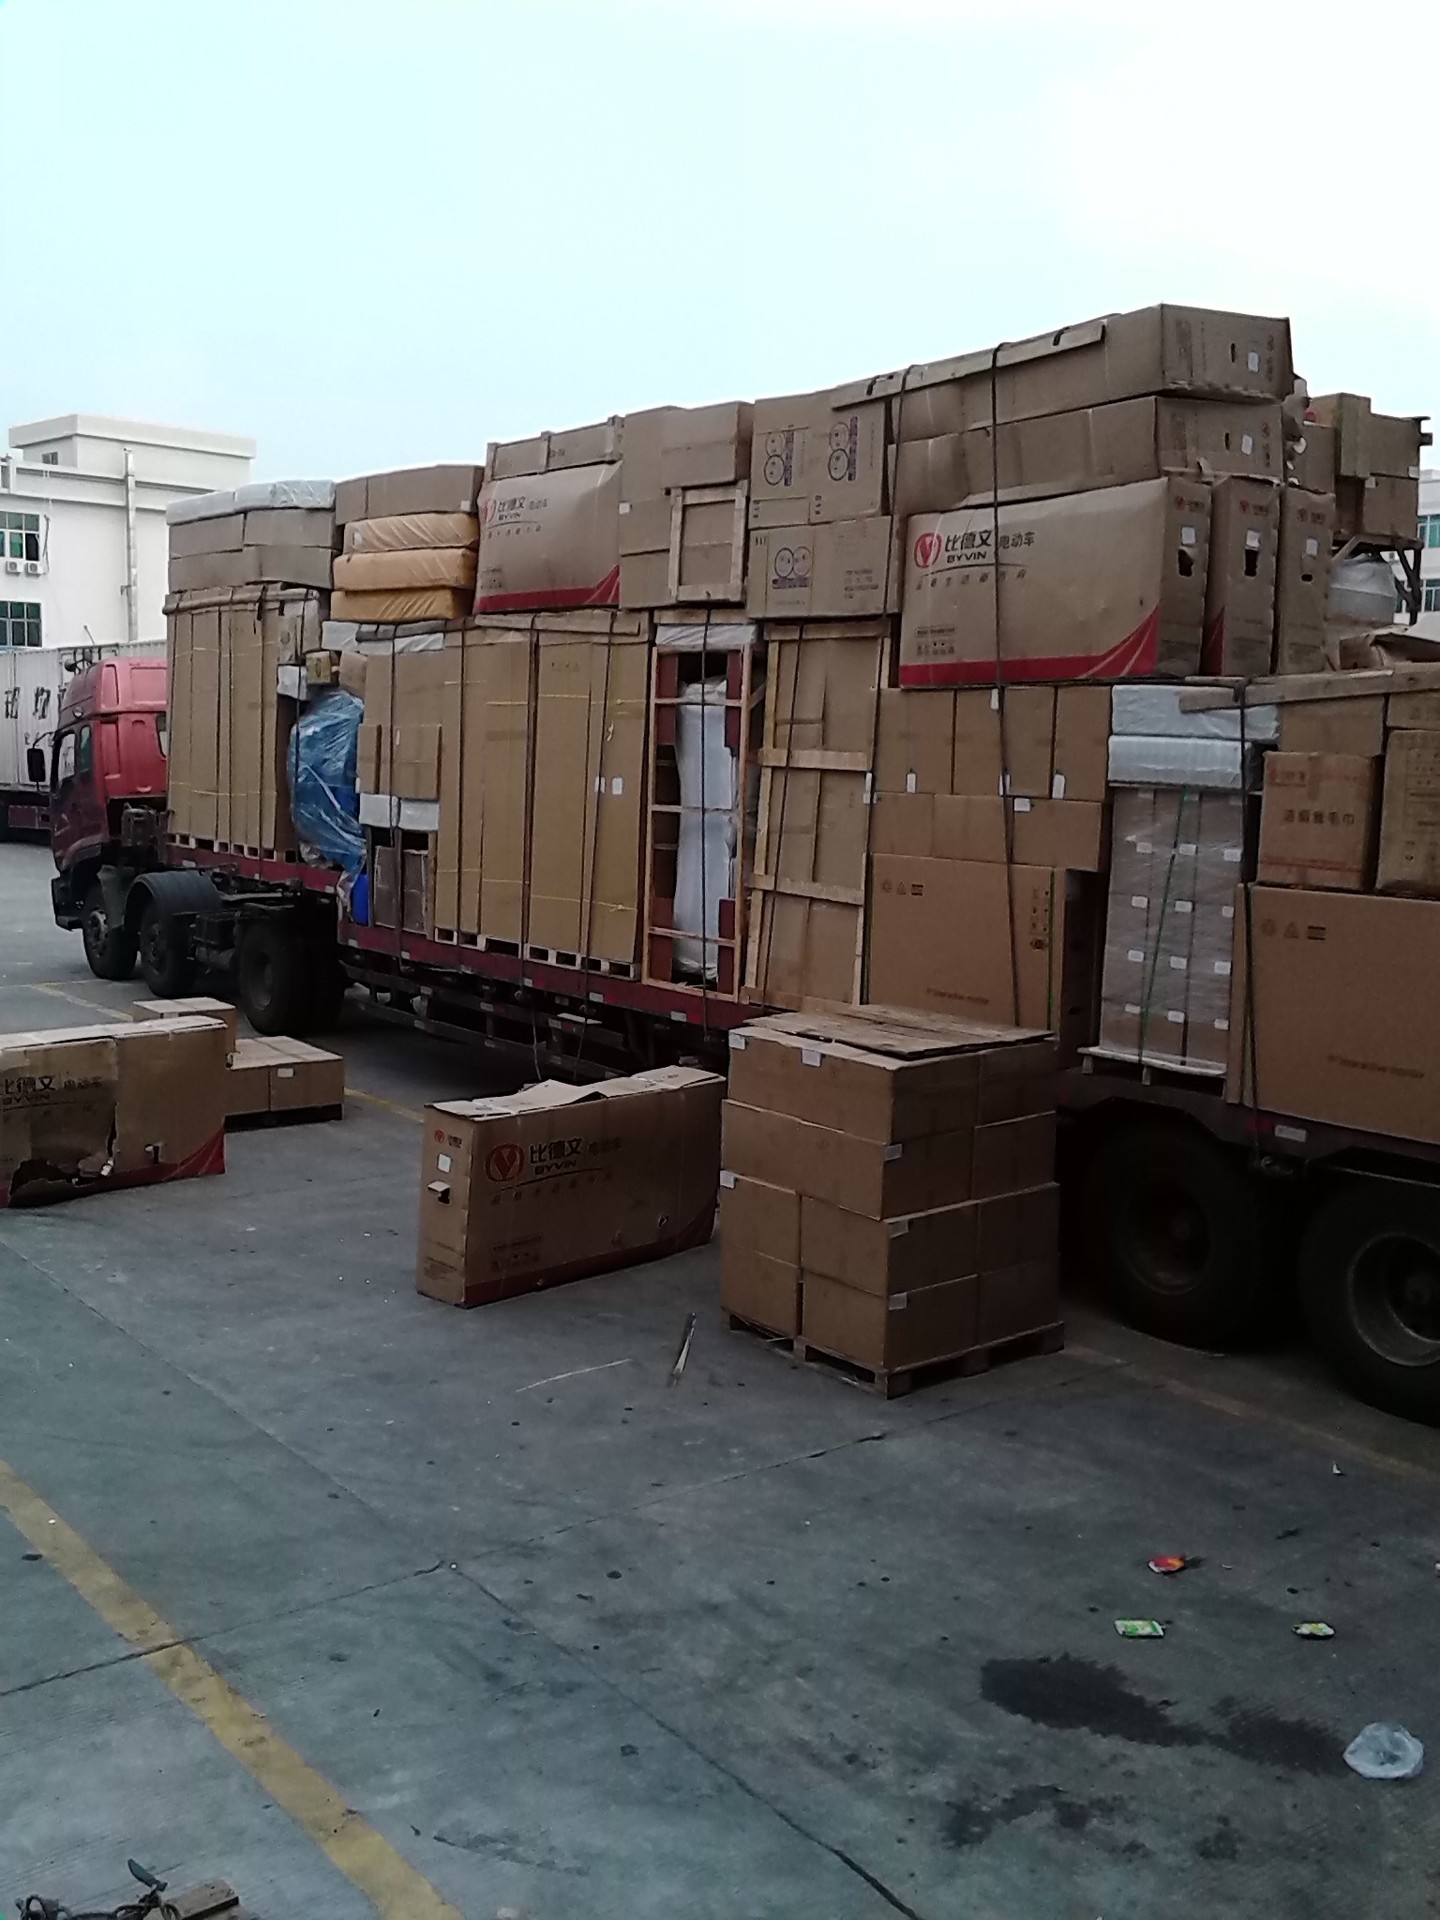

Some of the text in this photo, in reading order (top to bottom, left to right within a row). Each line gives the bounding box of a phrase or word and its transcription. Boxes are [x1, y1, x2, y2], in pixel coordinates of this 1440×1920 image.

[944, 529, 1036, 553] 比德文 电动车
[946, 551, 988, 564] BYVIN
[529, 1137, 582, 1163] 比德文
[534, 1160, 577, 1175] BYVIN
